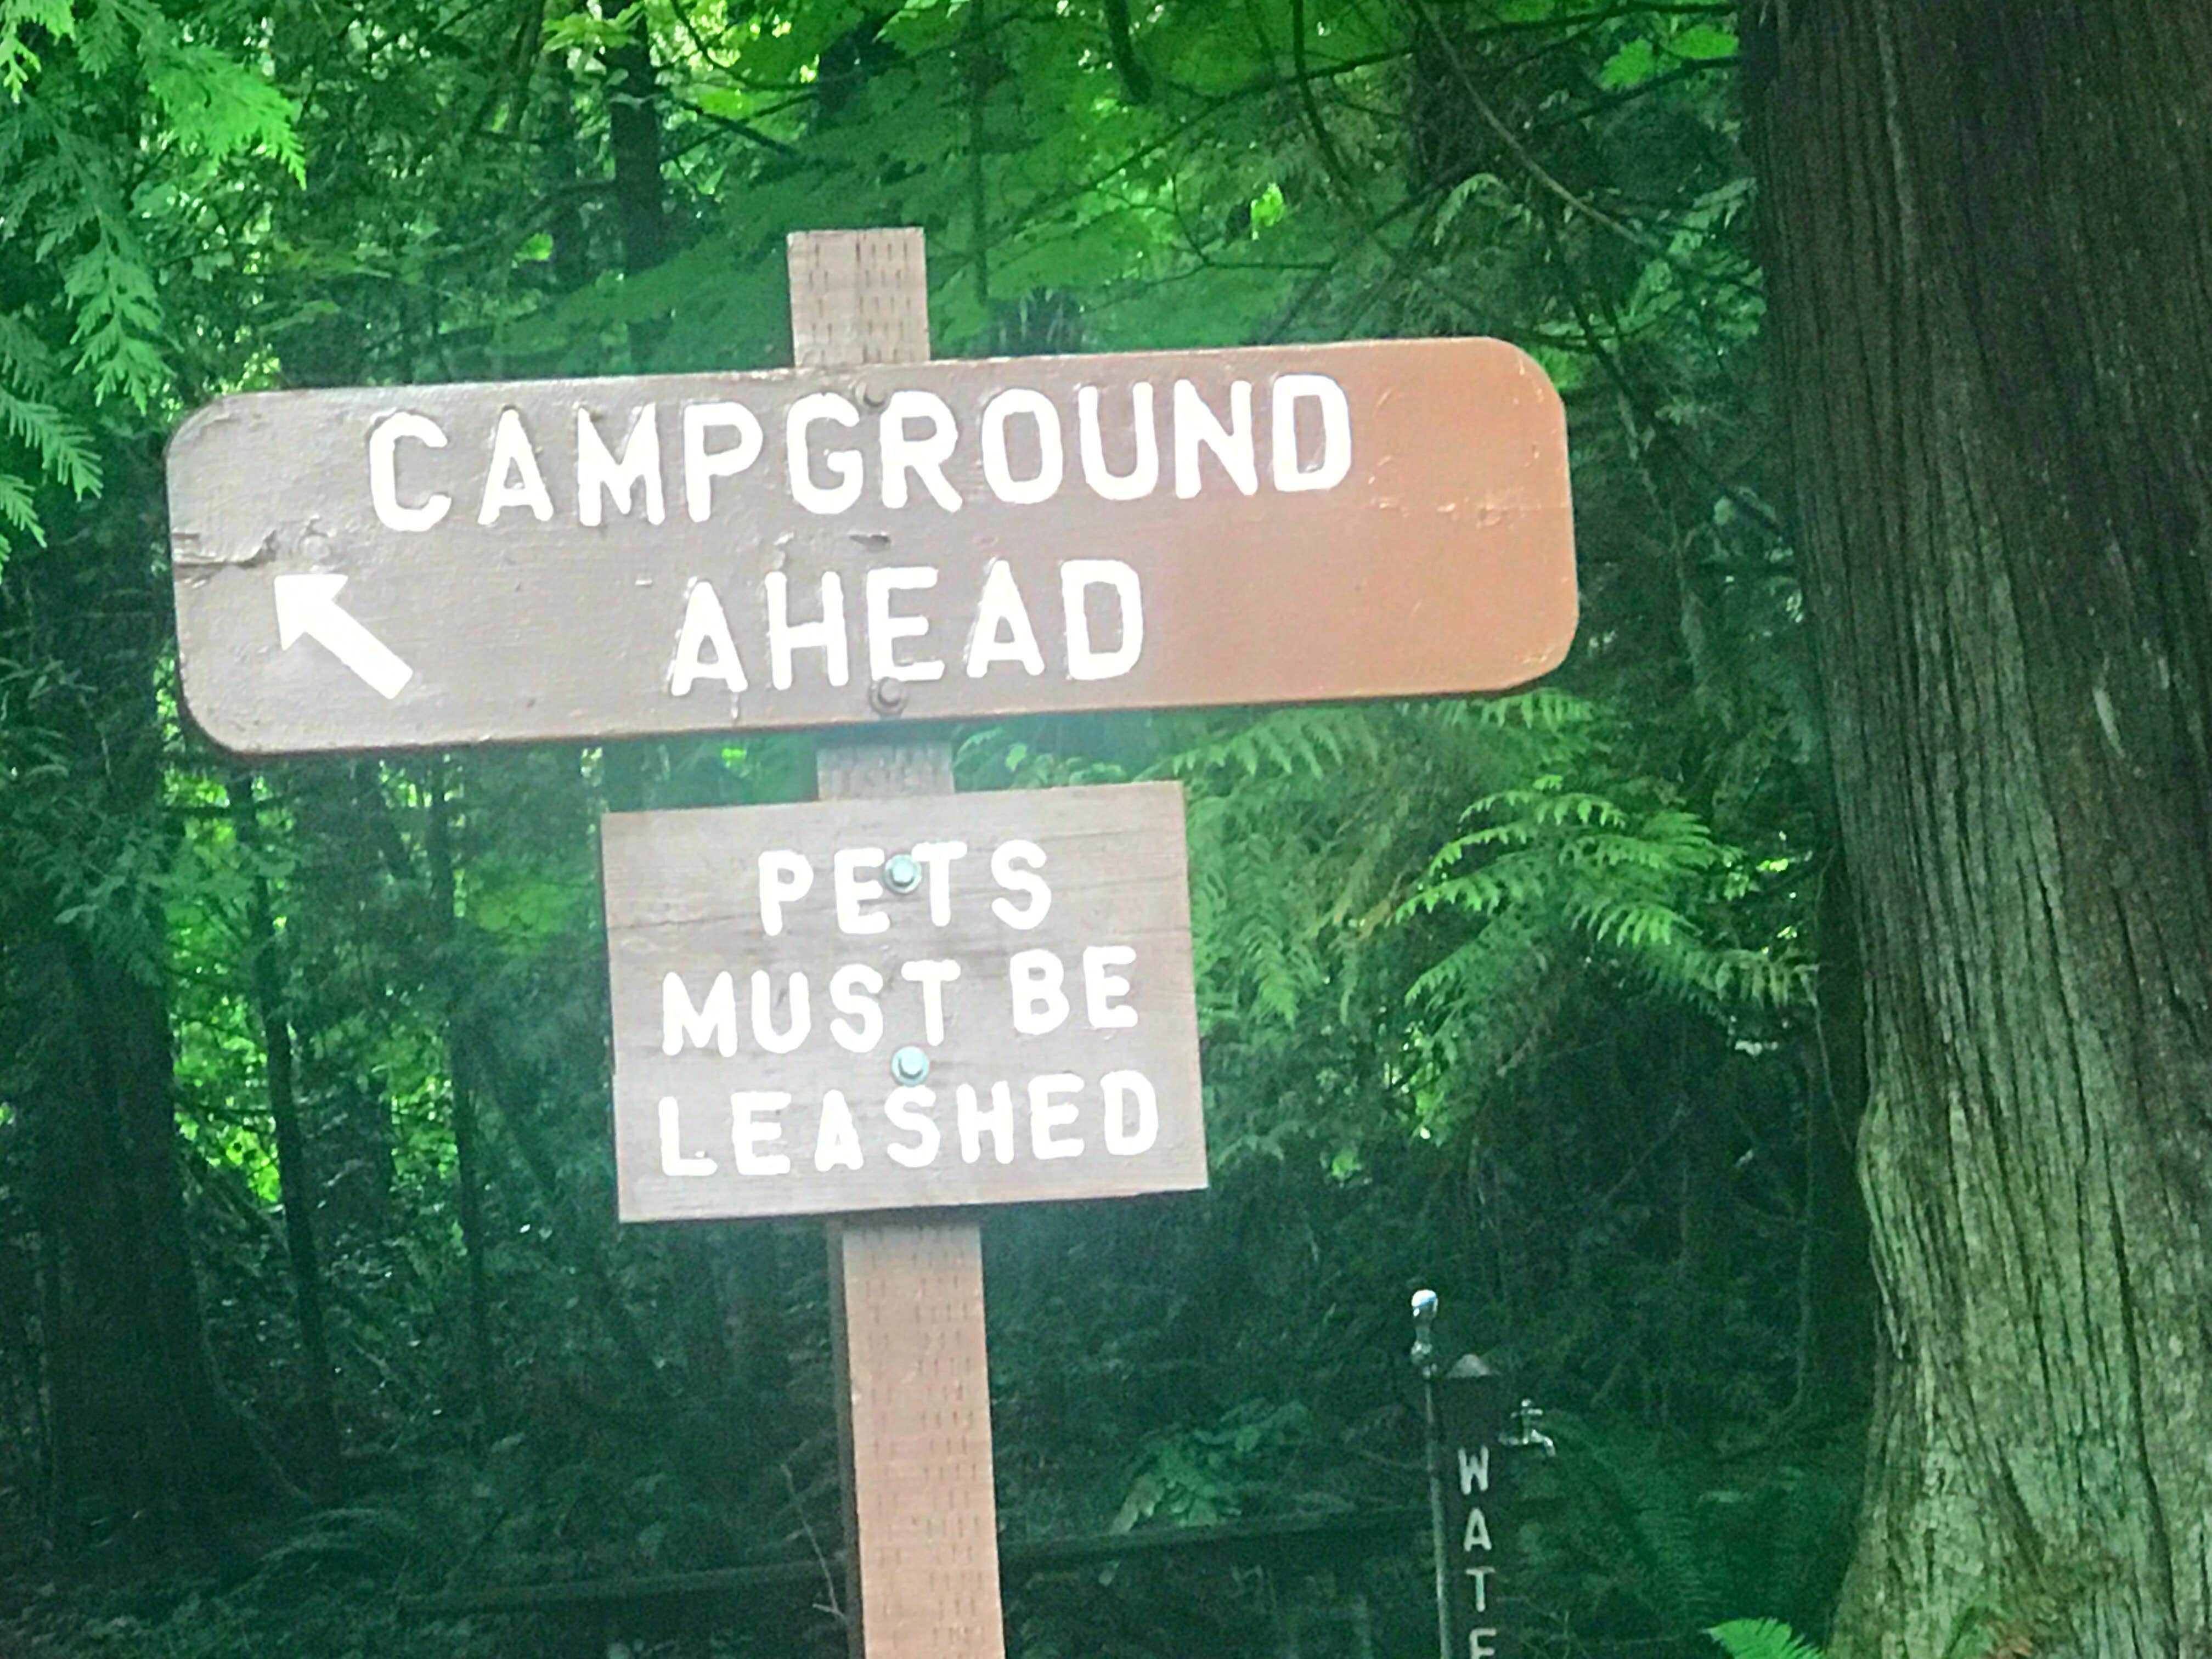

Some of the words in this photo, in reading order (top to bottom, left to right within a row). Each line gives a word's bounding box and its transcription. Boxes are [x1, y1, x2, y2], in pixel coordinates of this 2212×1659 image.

[368, 375, 1352, 532] CAMPGROUND
[670, 559, 1144, 697] AHEAD
[758, 839, 1052, 936] PETS
[662, 959, 961, 1057] MUST
[1009, 945, 1138, 1035] BE
[659, 1069, 1159, 1176] LEASHED
